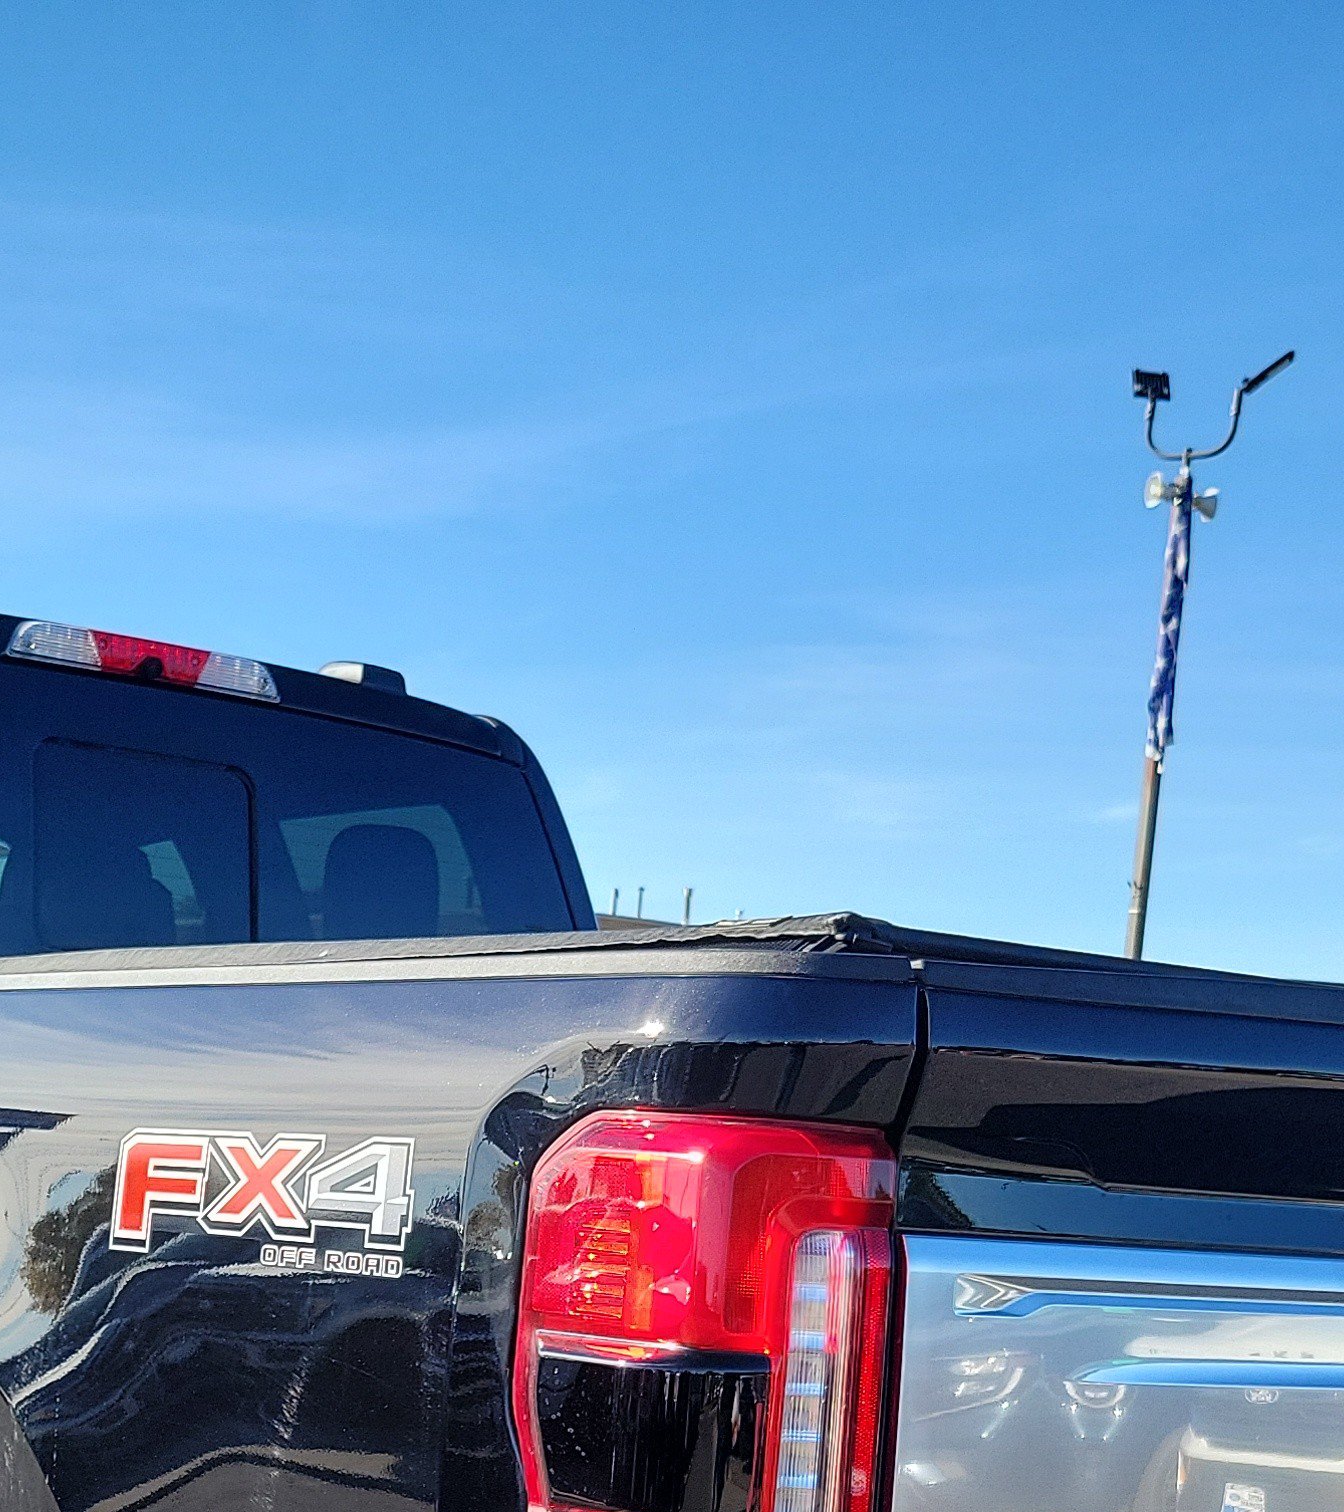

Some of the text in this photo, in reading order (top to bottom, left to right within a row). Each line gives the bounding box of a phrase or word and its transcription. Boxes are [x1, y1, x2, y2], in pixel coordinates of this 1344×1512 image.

[109, 1127, 415, 1253] FX4
[260, 1243, 403, 1278] OFF ROAD
